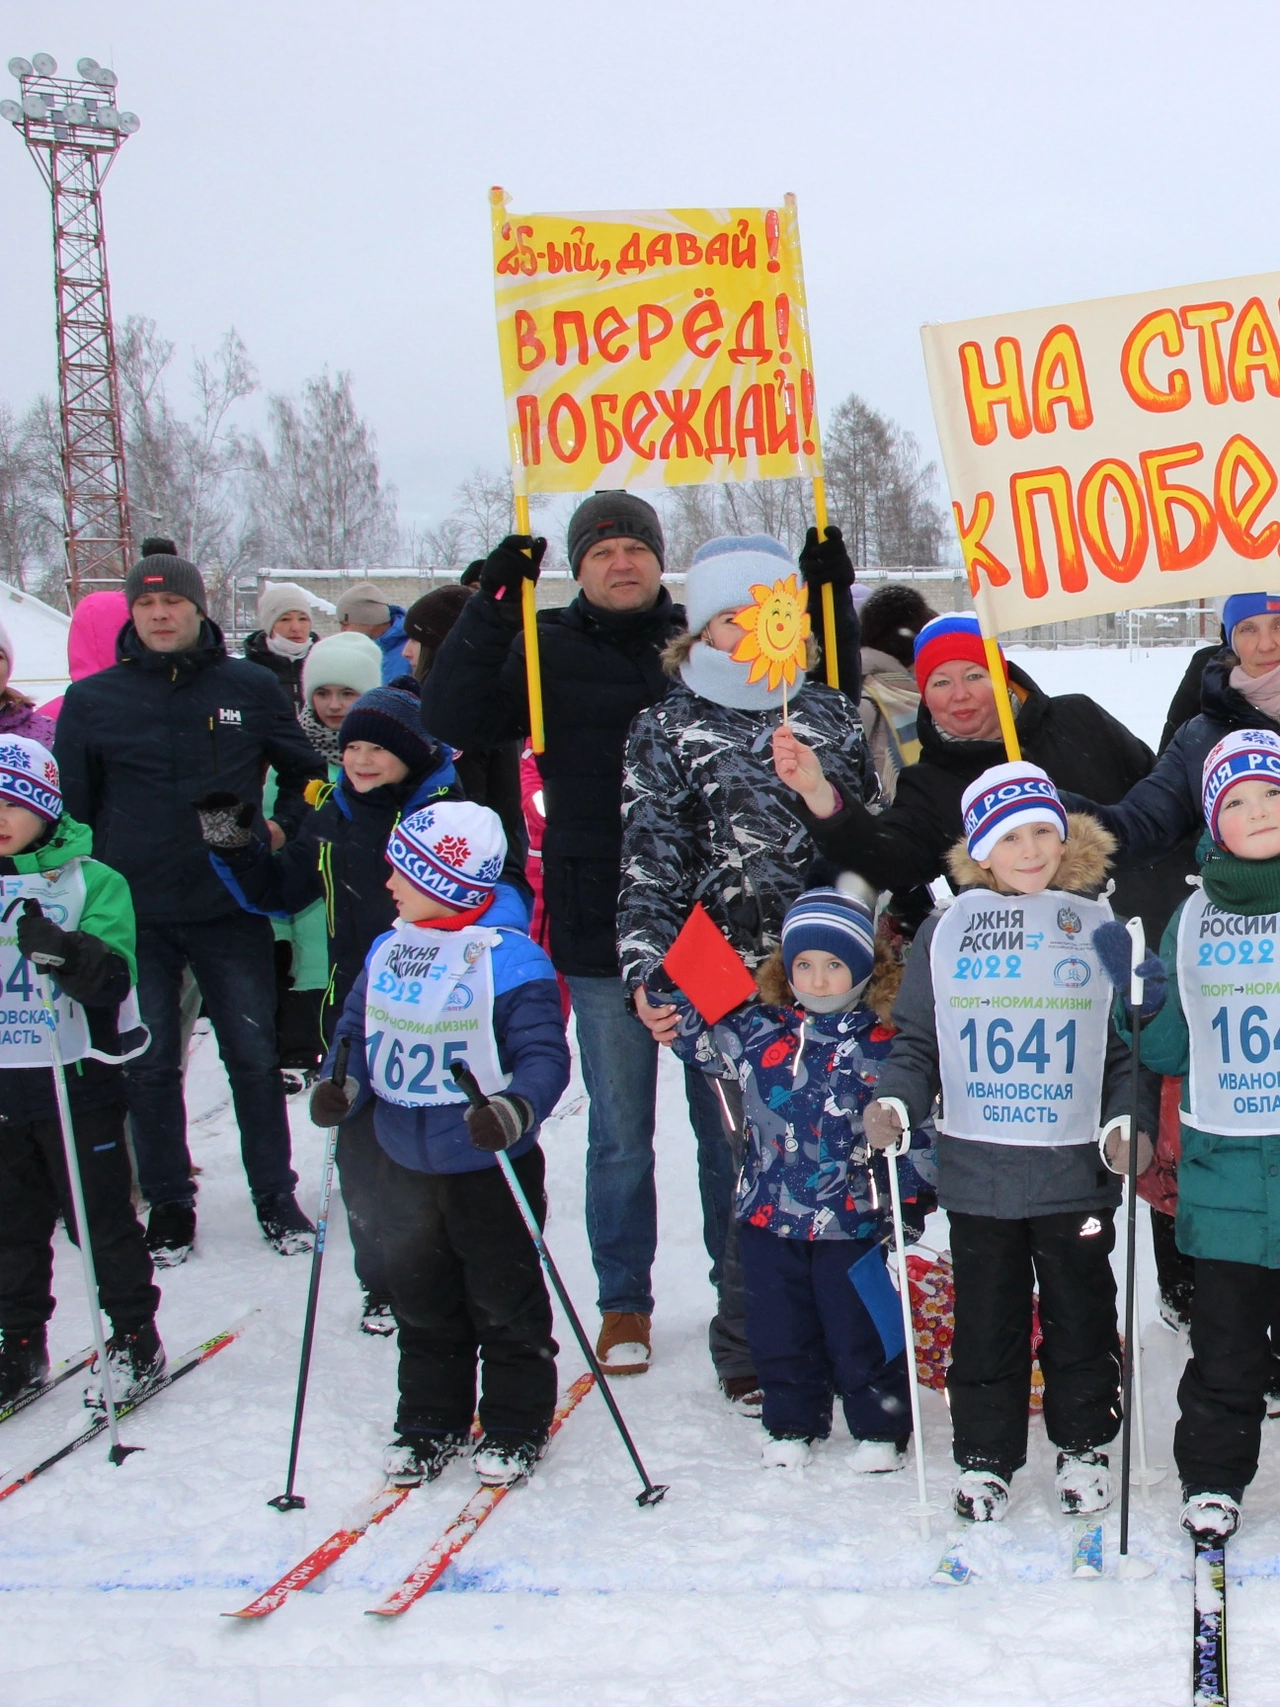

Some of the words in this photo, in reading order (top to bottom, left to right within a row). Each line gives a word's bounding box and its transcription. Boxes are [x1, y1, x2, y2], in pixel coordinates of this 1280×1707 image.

[959, 323, 1094, 446] НА
[516, 368, 816, 466] ПОБЕЖДАЙ!
[219, 708, 242, 721] HH
[1199, 916, 1277, 938] РОССИИ
[1197, 939, 1274, 967] 2022
[952, 955, 1022, 980] 2022
[991, 996, 1045, 1009] НОРМА
[1045, 997, 1092, 1010] ЖИЗНИ
[0, 1029, 42, 1044] АСТЬ
[959, 1018, 1077, 1075] 1641
[366, 1030, 470, 1095] 1625
[965, 1081, 1073, 1101] ИВАНОВСКАЯ
[982, 1104, 1059, 1124] ОБЛАСТЬ
